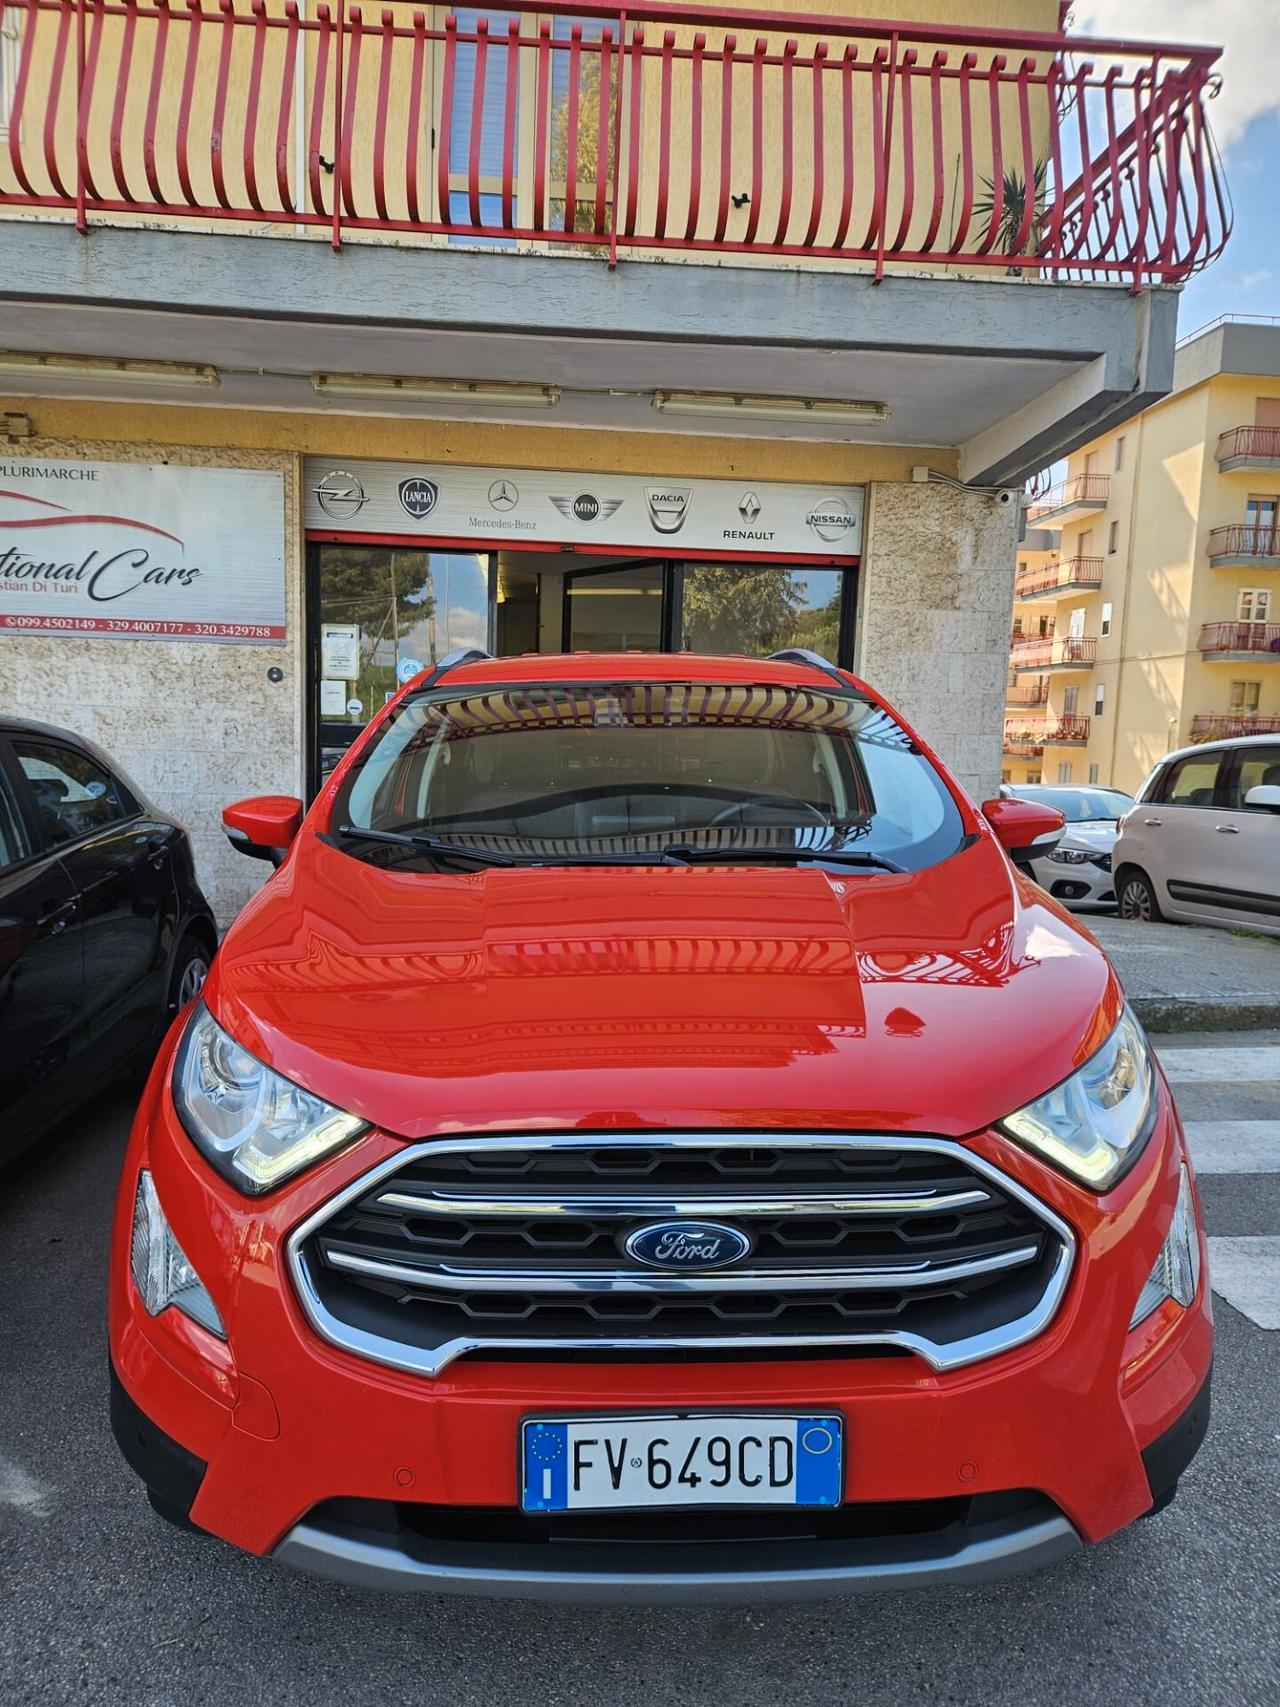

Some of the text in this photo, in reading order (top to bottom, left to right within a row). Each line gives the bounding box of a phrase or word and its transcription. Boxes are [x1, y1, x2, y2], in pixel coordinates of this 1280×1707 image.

[405, 491, 432, 503] LANCIA
[651, 494, 685, 503] DACIA
[574, 502, 599, 513] MINI
[469, 517, 537, 530] Mercedes-Benz
[811, 514, 852, 525] NISSAN
[723, 530, 775, 541] RENAULT
[87, 548, 204, 602] Cars
[32, 582, 47, 592] Di
[17, 617, 96, 630] 099.4502149
[107, 620, 184, 634] 329.4007177
[195, 624, 271, 638] 320.3429788
[655, 1231, 720, 1259] Ford
[573, 1436, 794, 1491] FV 649CD
